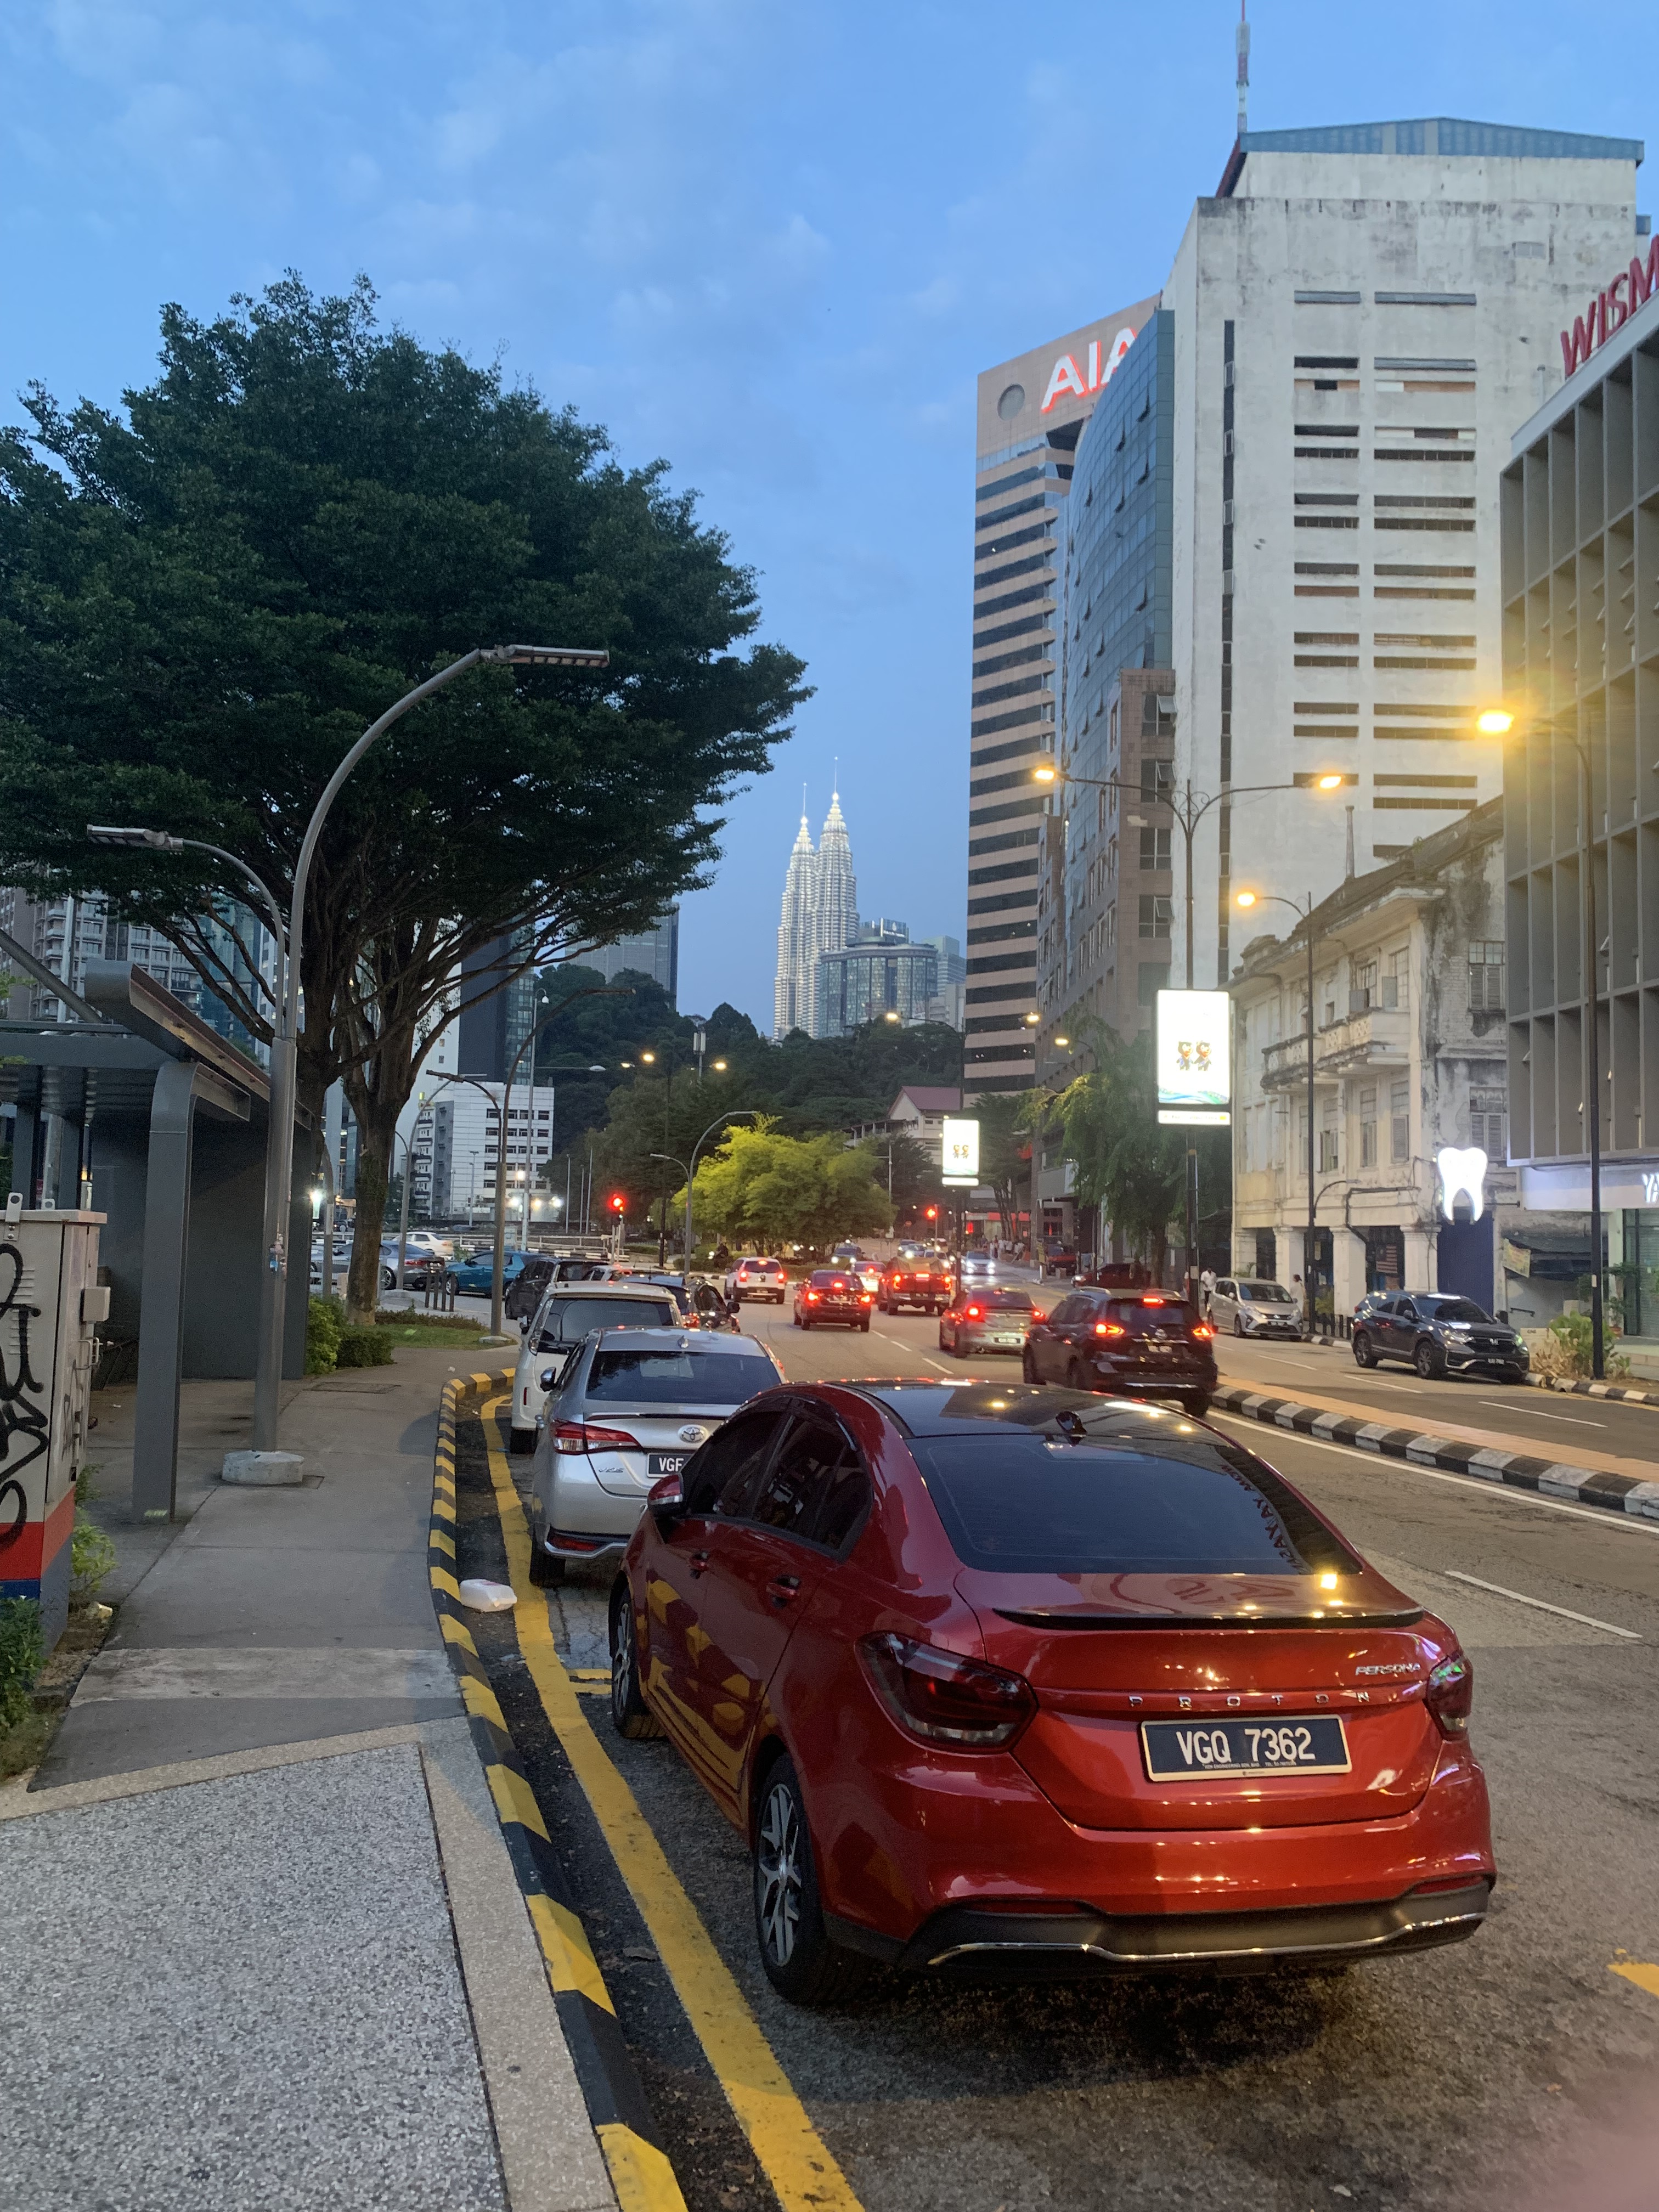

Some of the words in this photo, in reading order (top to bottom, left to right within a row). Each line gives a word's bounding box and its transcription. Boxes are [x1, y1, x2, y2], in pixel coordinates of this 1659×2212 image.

[1041, 327, 1138, 413] AIA
[659, 1457, 684, 1472] VGF
[1129, 1691, 1370, 1707] PROTON
[1176, 1730, 1231, 1765] VGQ
[1244, 1727, 1316, 1762] 7362
